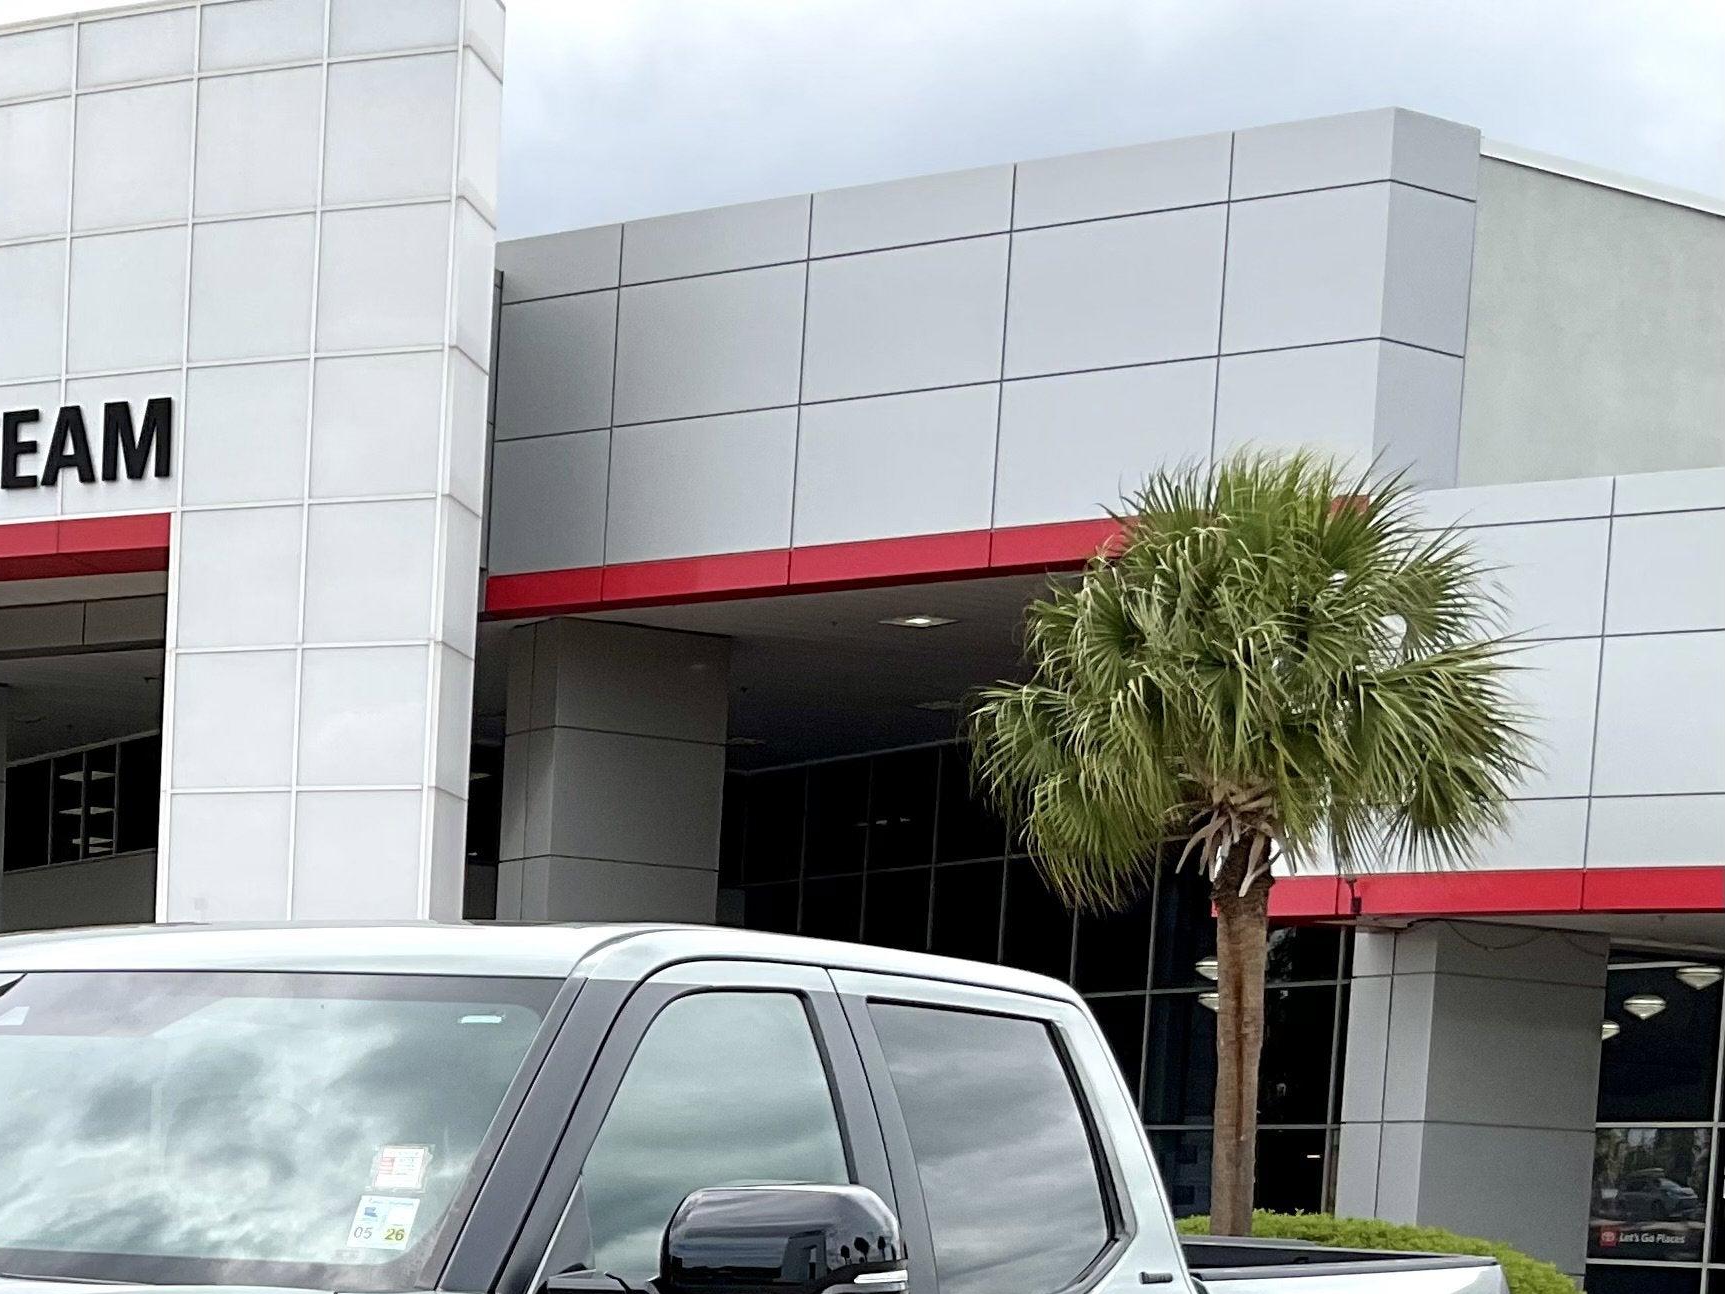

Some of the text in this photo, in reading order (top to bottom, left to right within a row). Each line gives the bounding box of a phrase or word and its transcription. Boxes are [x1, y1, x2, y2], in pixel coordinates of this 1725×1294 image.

[353, 1226, 405, 1241] 05 26
[1619, 1232, 1686, 1244] Let's Go Places
